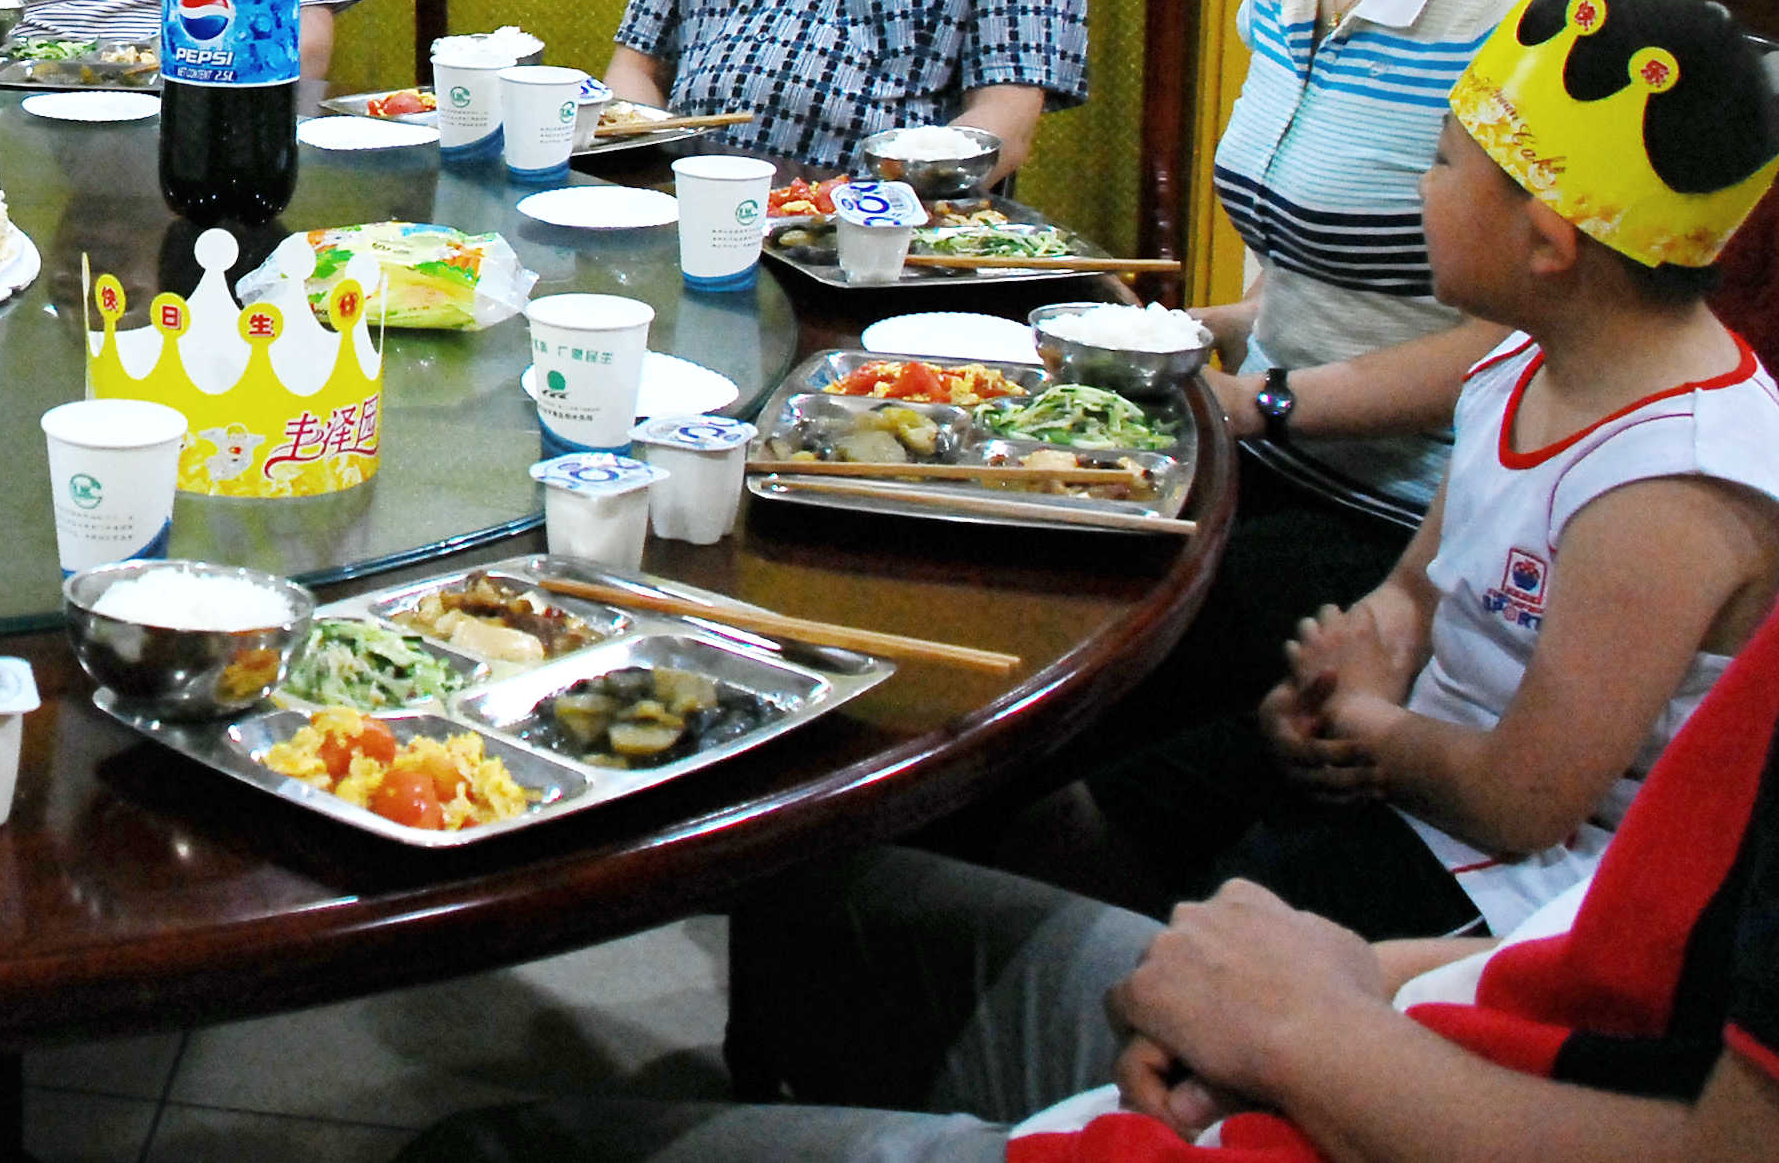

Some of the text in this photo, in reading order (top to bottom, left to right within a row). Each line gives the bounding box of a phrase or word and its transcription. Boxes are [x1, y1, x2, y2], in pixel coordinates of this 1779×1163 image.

[175, 47, 235, 67] PEPSI
[161, 305, 182, 331] 日
[247, 313, 276, 338] 生
[263, 393, 380, 479] 丰泽园
